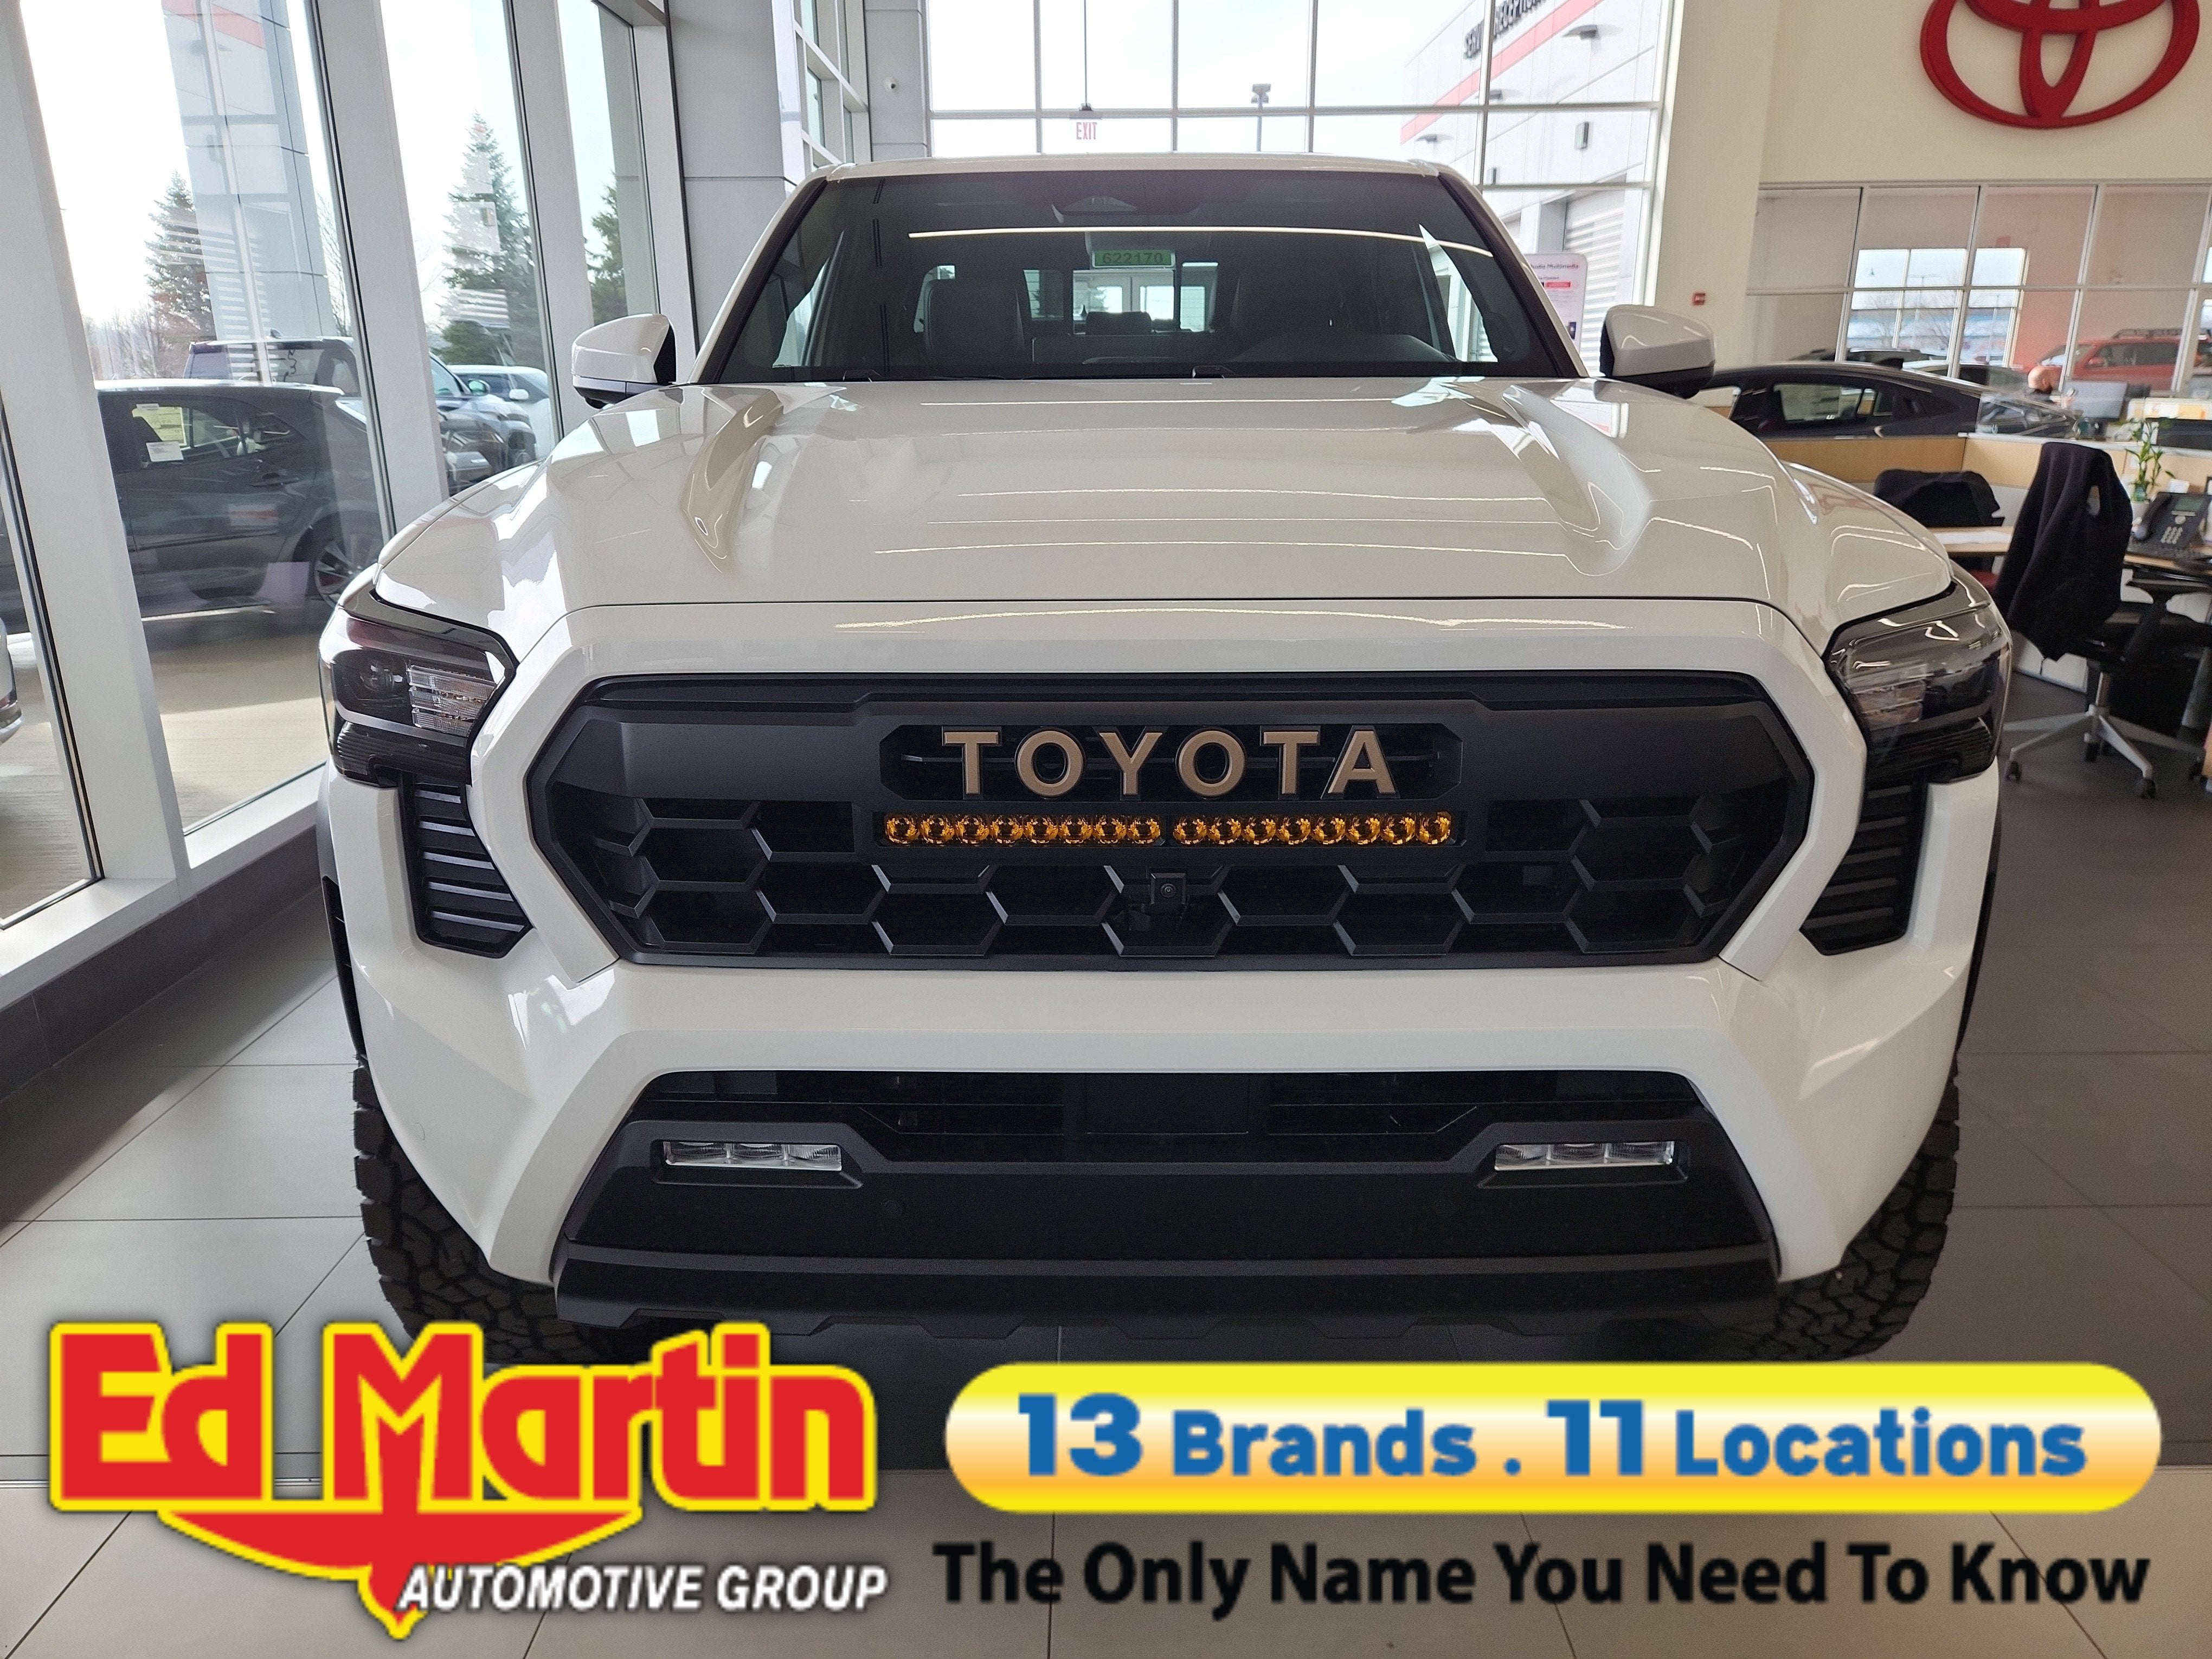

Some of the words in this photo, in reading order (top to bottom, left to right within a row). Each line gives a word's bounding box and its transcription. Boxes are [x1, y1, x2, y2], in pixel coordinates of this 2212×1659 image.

[1463, 18, 1484, 59] SERV
[1076, 122, 1097, 140] EXIT
[1103, 252, 1163, 264] 622170
[942, 729, 1396, 796] TOYOTA
